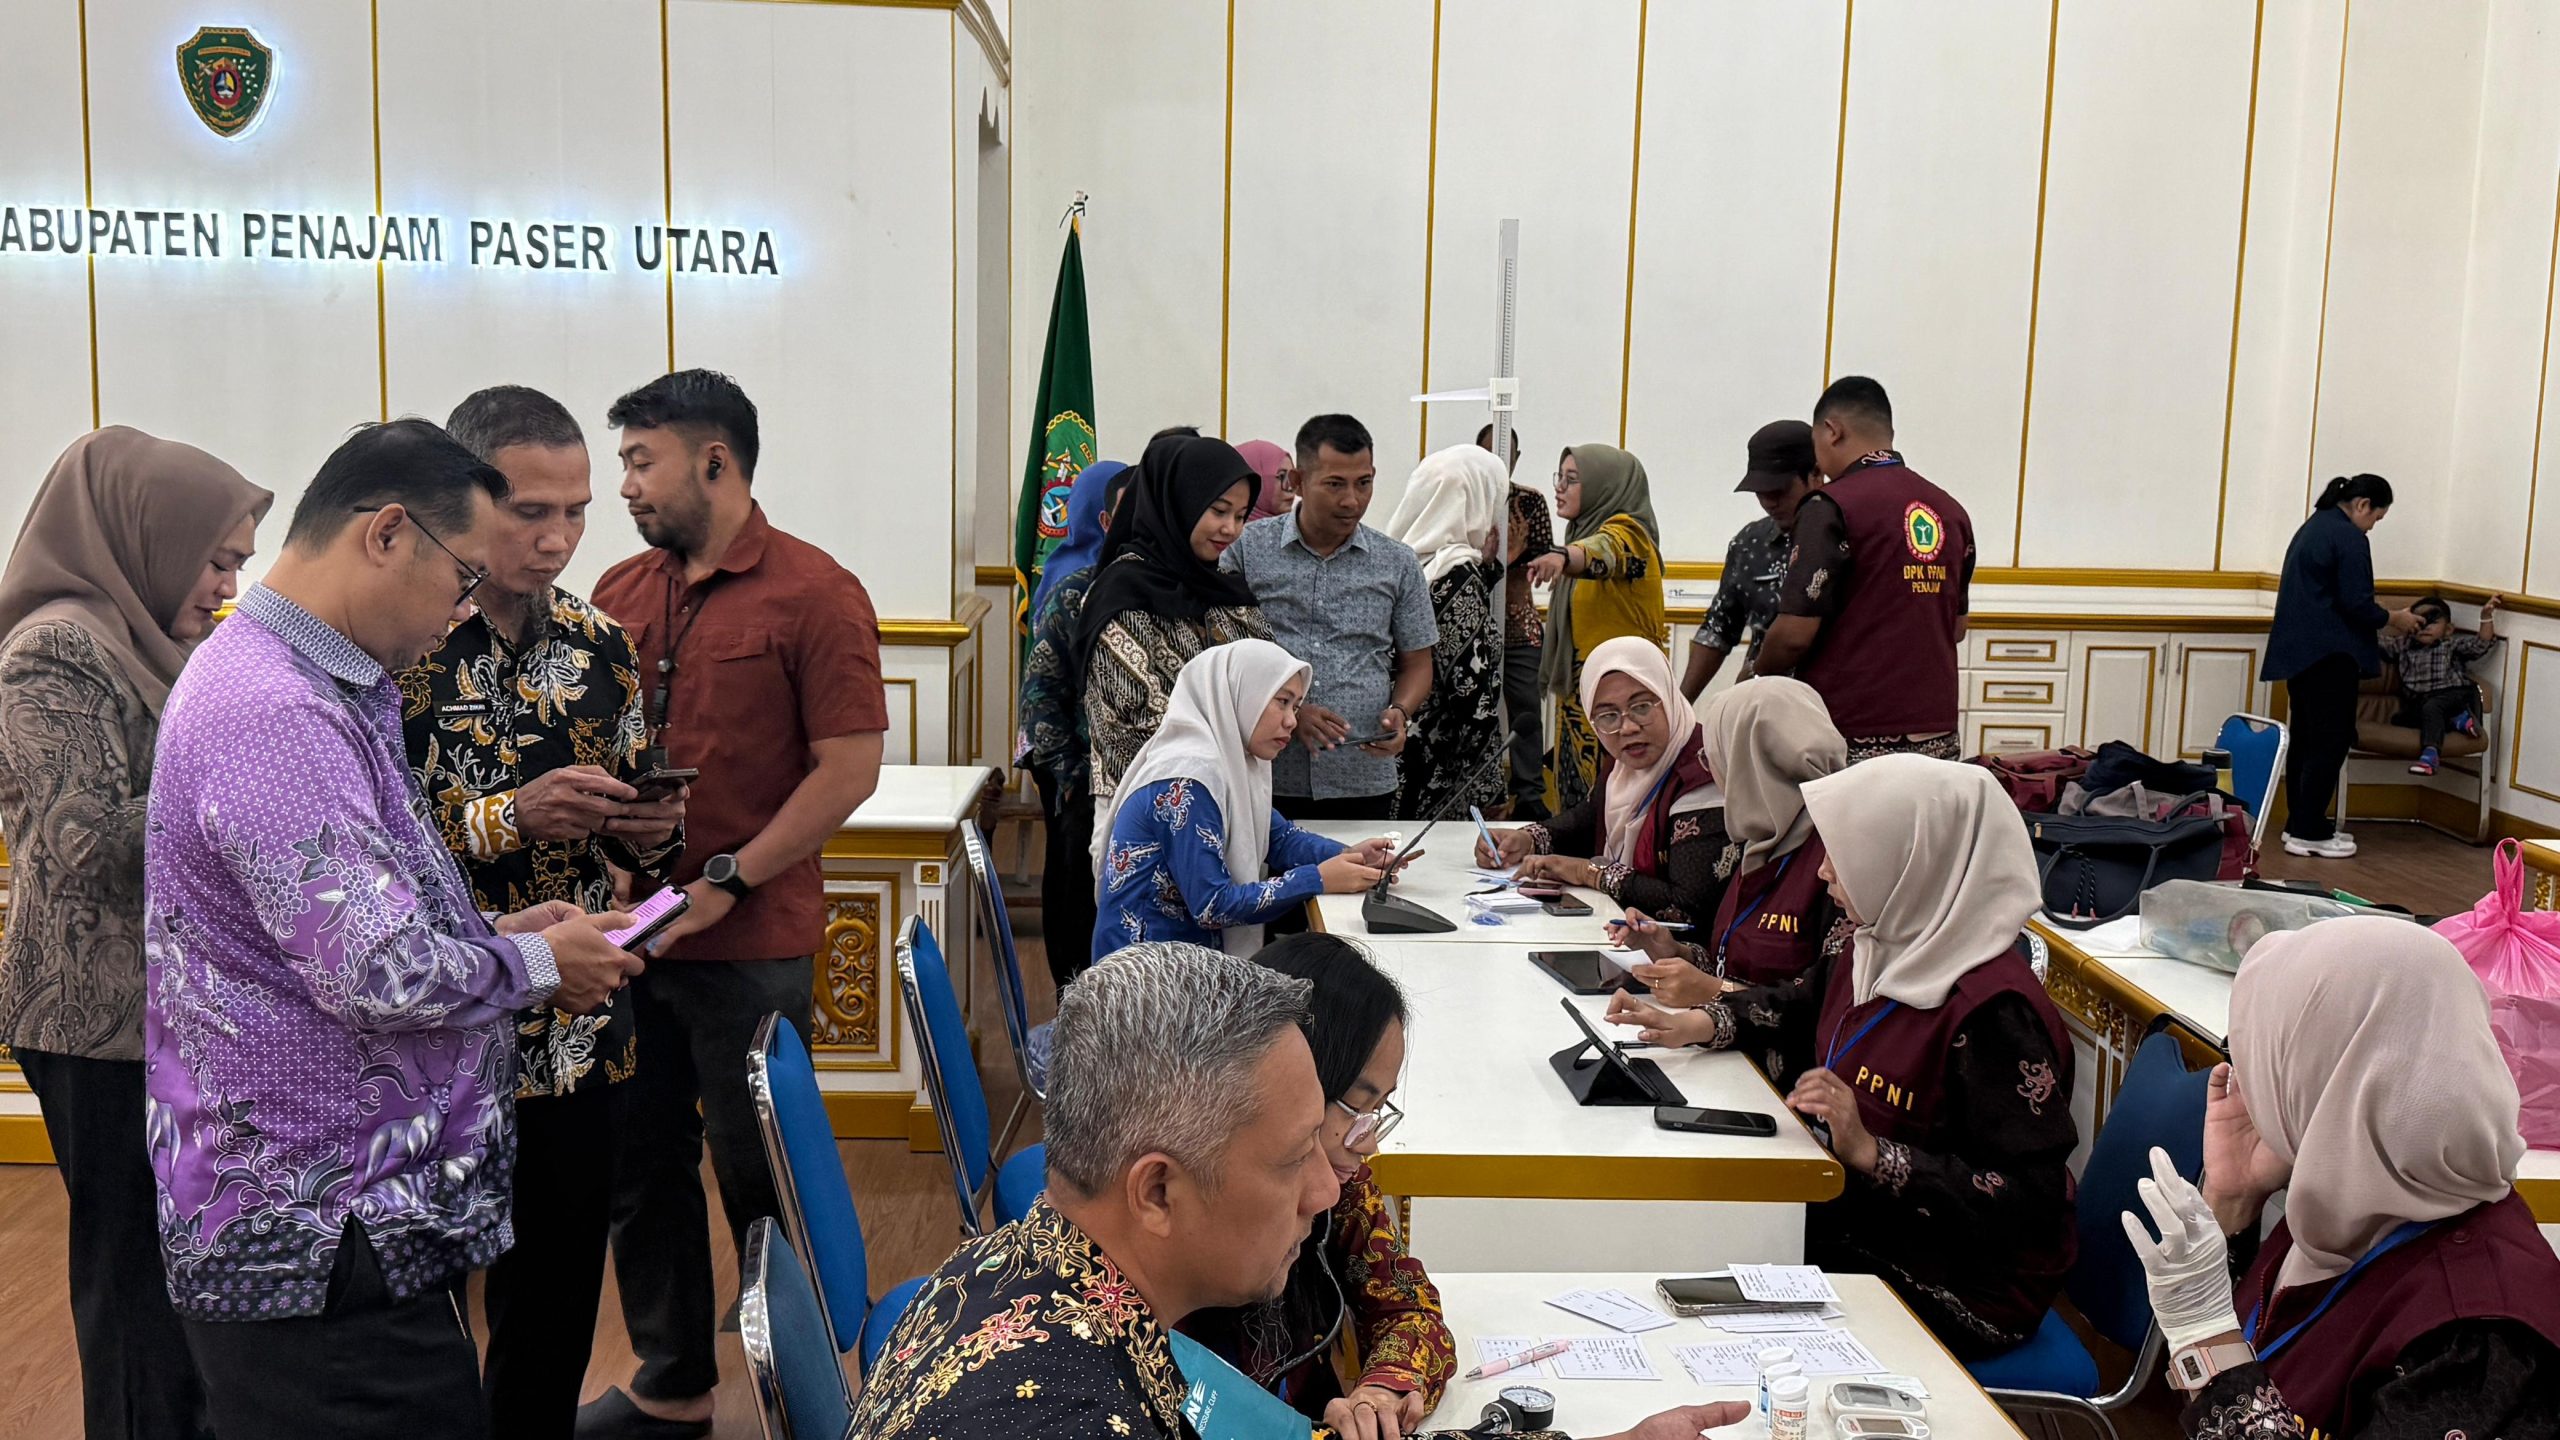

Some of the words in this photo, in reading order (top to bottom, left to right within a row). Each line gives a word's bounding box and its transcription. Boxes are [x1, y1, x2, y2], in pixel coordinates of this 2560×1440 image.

[243, 213, 443, 262] PENAJAM
[470, 221, 608, 271] PASER
[634, 225, 779, 275] UTARA
[1903, 565, 1925, 580] DPK
[1927, 565, 1947, 581] PPNI
[1757, 912, 1799, 933] PPNI
[1855, 1065, 1914, 1111] PPNI
[1208, 1389, 1219, 1406] CUFF
